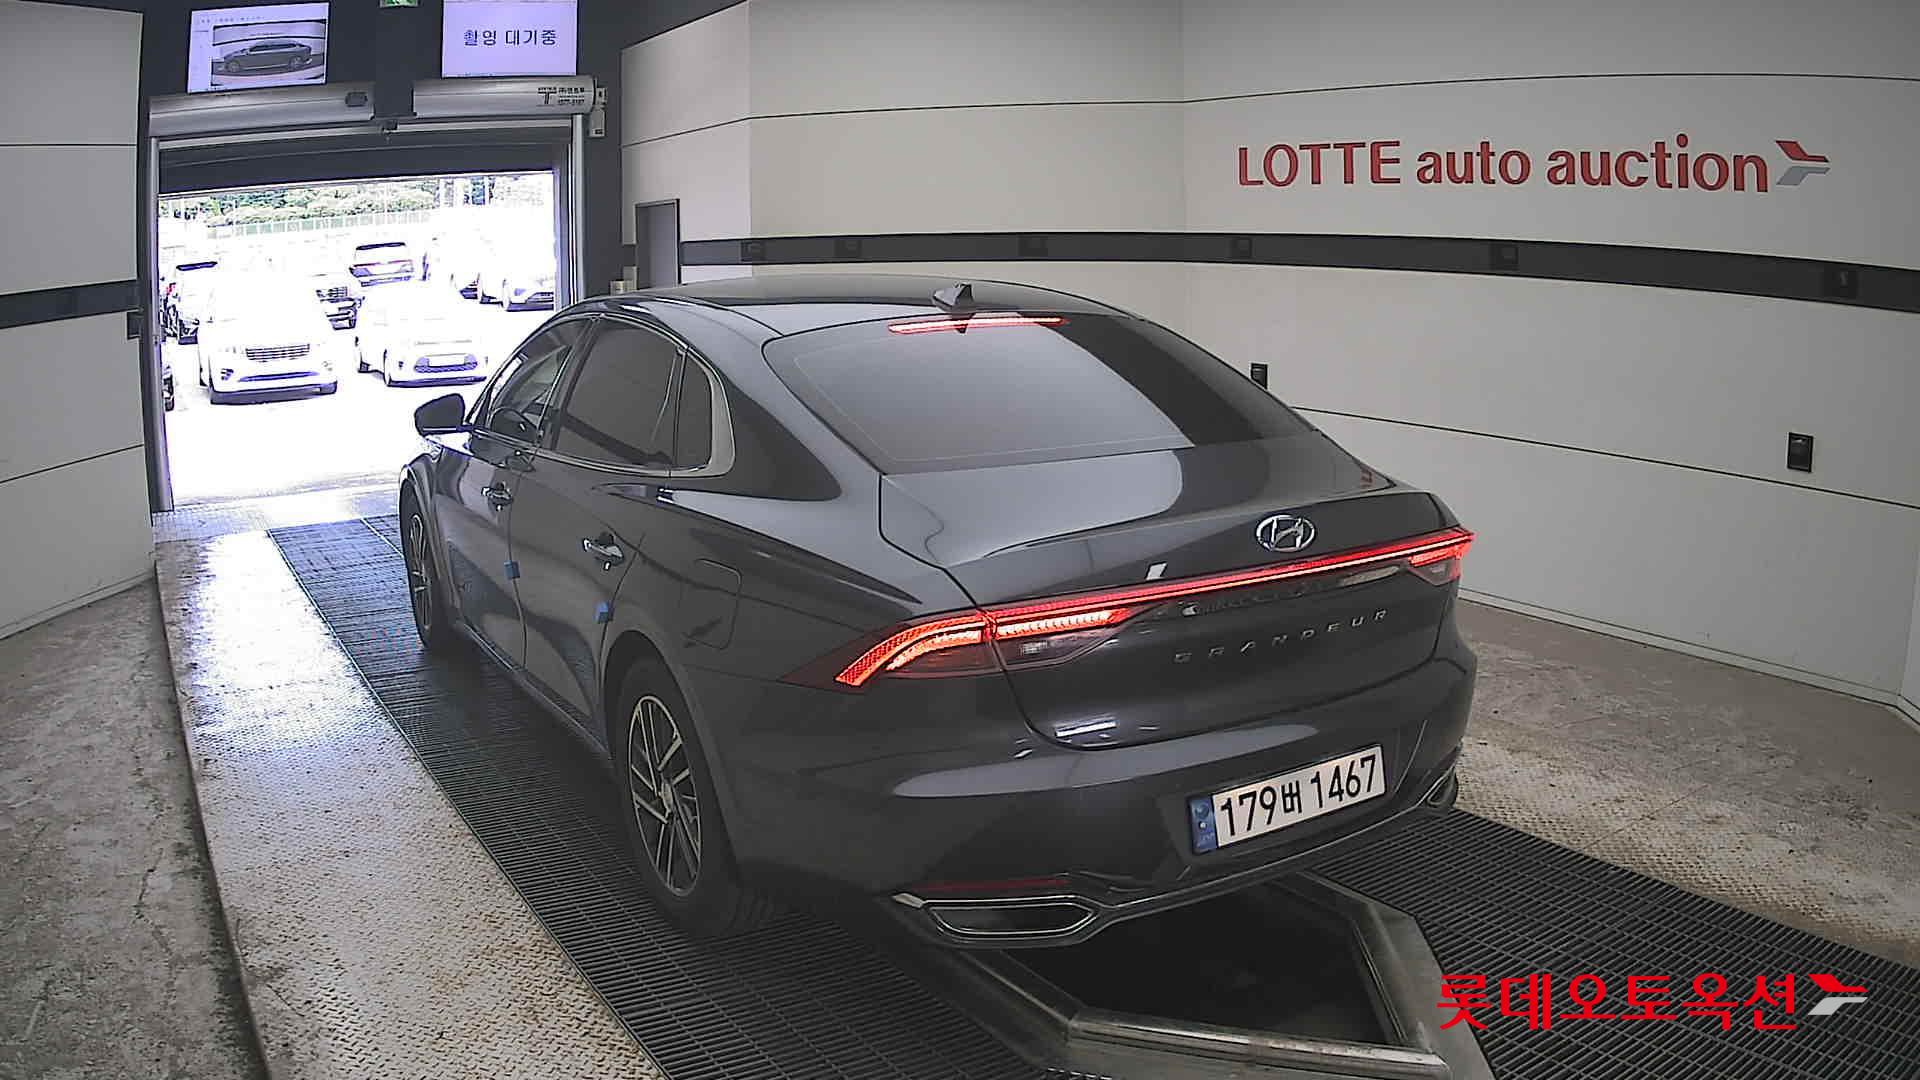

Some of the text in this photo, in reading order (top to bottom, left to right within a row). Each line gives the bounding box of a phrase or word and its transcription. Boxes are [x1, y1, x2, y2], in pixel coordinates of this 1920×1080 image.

[505, 30, 557, 46] 대기중
[1238, 134, 1768, 193] LOTTE auto auction
[1174, 608, 1387, 664] GRANDEUR
[1220, 753, 1376, 836] 179버 1467
